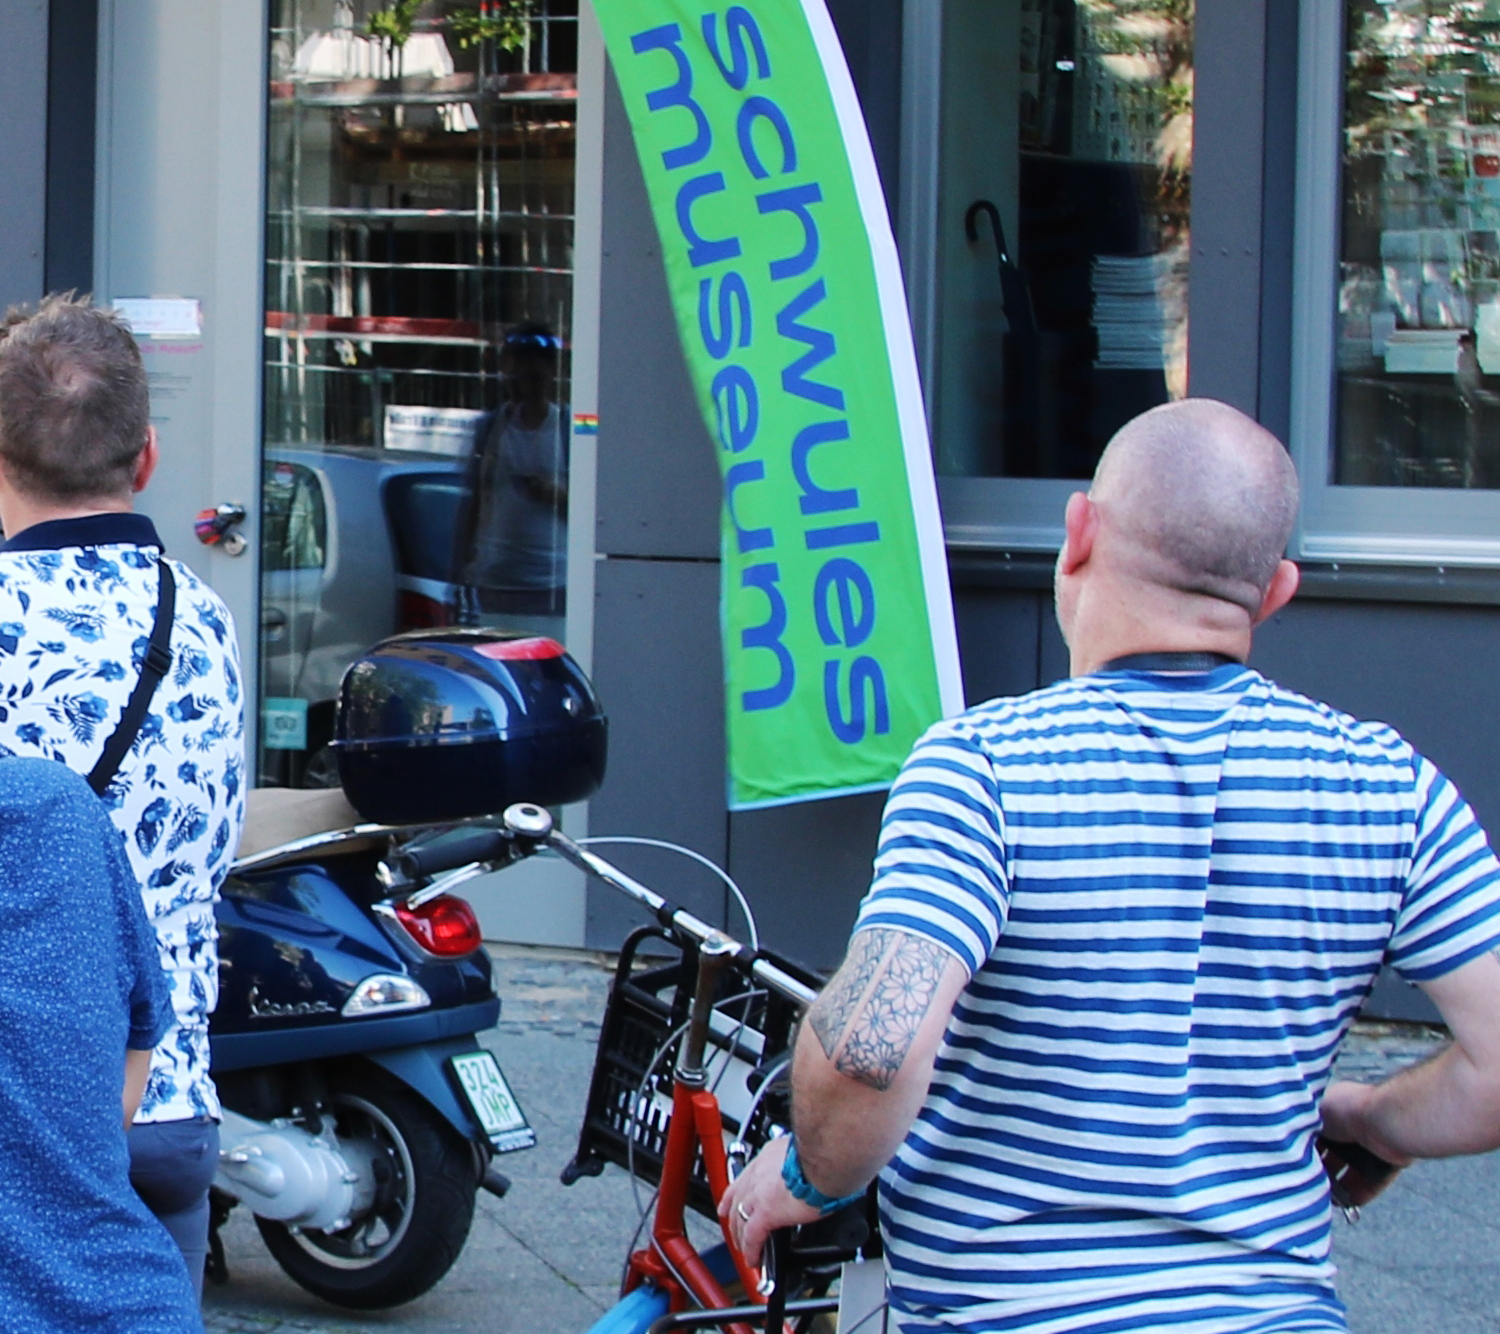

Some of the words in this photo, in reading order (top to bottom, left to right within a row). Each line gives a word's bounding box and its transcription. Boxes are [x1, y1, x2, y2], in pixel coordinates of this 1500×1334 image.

[631, 23, 796, 713] museum
[702, 6, 891, 746] schwules
[459, 1058, 500, 1092] 324
[480, 1092, 513, 1126] JMP
